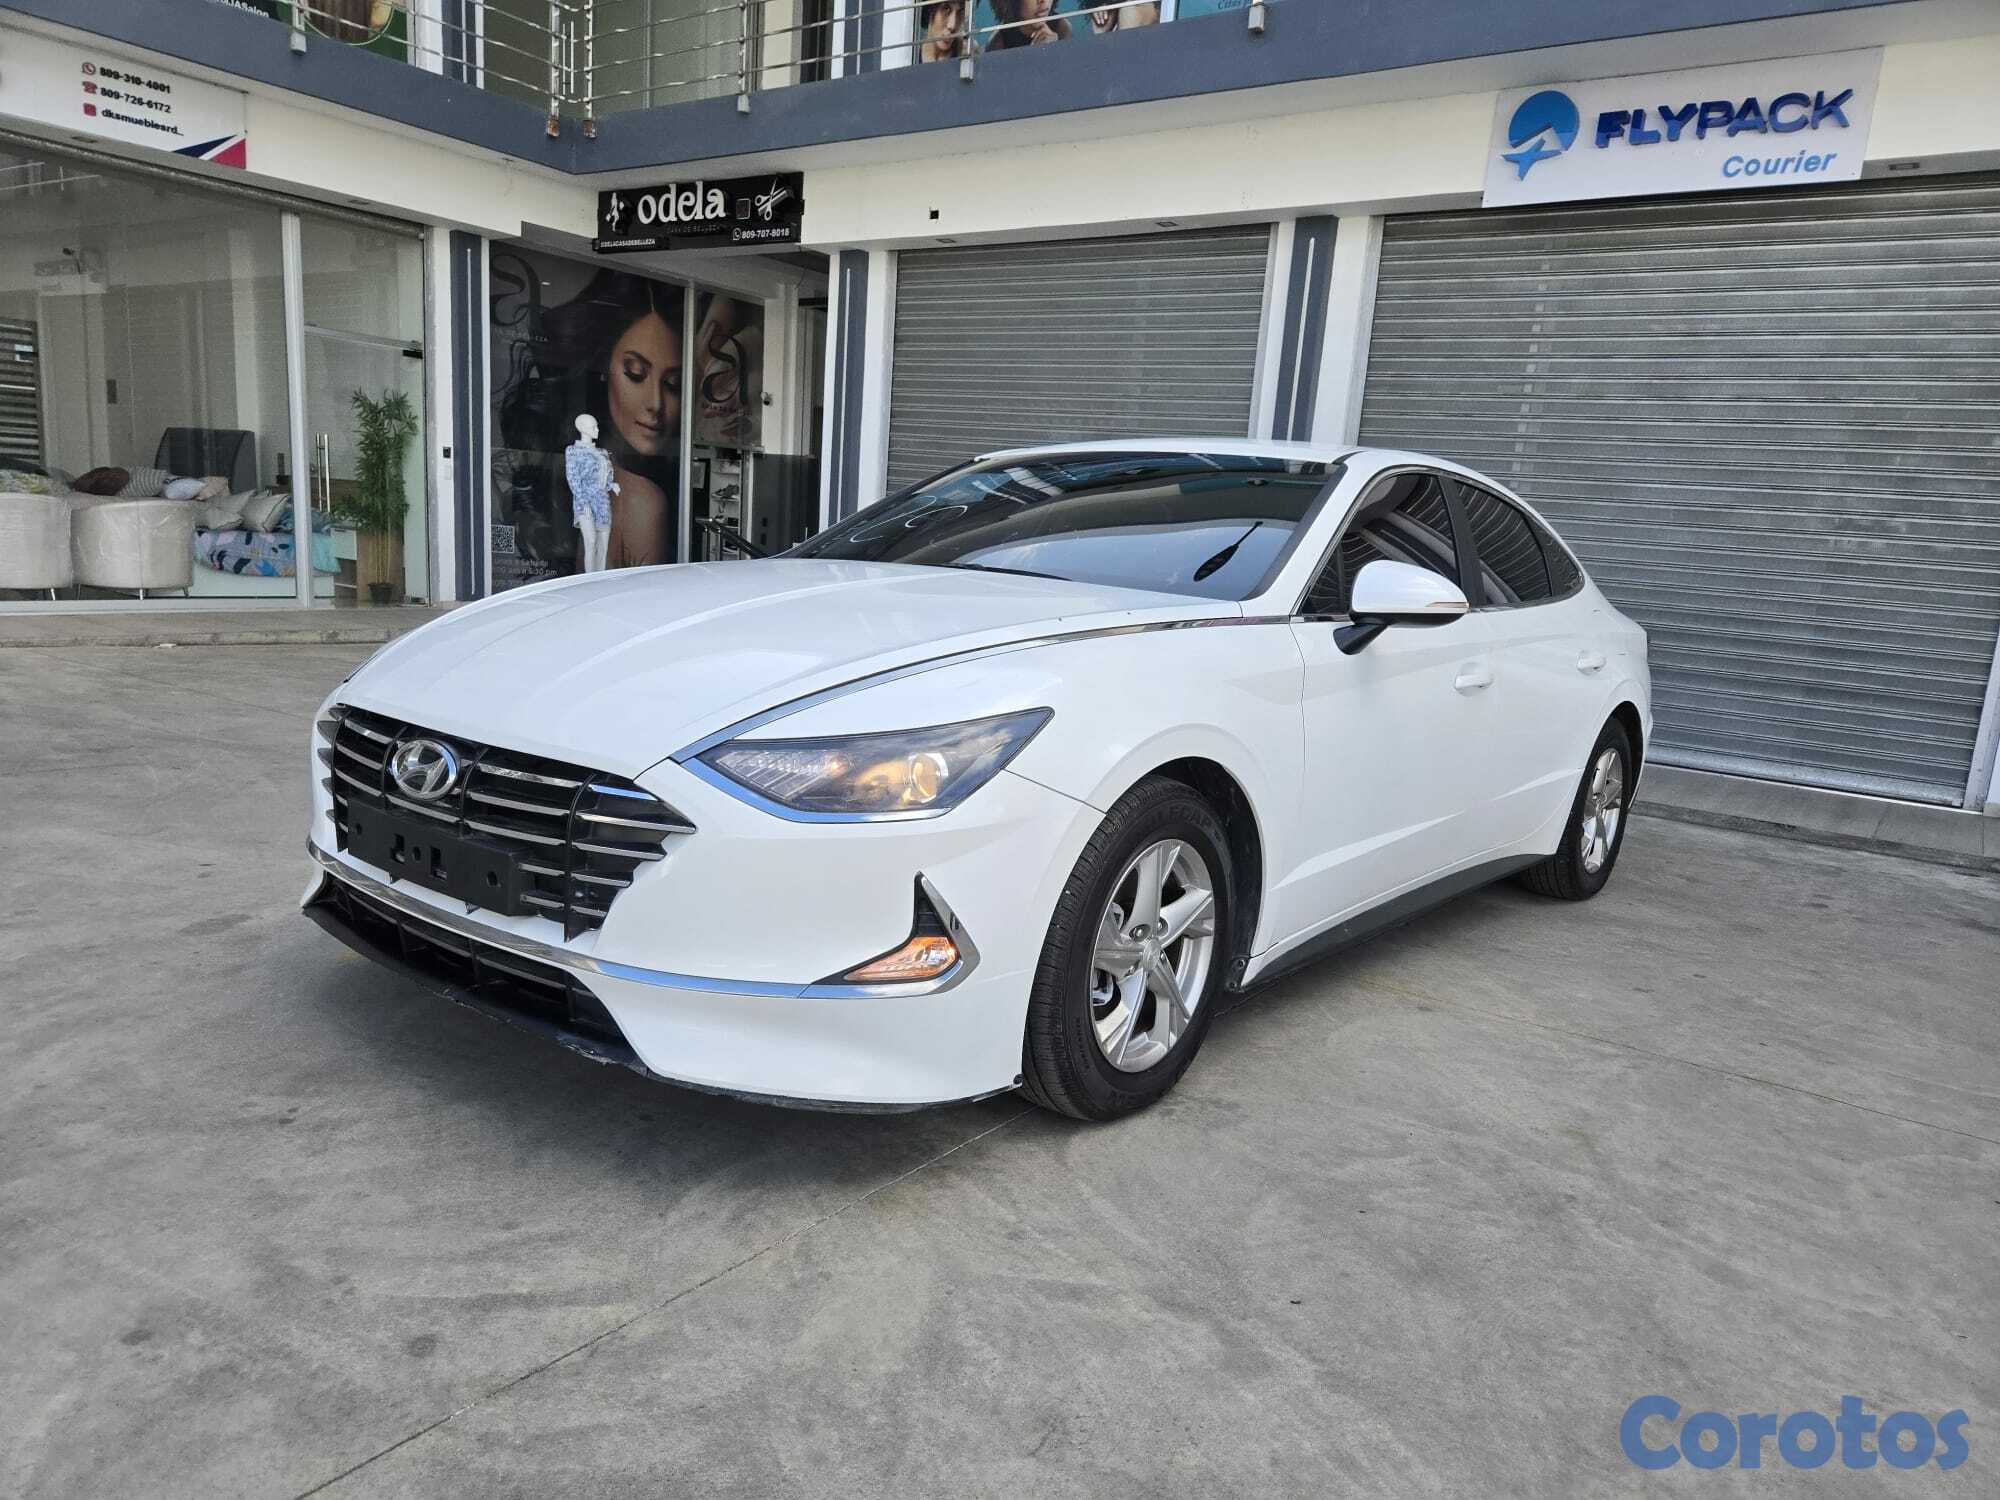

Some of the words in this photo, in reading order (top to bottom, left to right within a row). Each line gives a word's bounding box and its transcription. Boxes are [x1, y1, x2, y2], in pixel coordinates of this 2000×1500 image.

[101, 88, 172, 114] 809-726-6172
[1595, 89, 1853, 148] FLYPACK
[1722, 150, 1837, 178] Courier
[637, 181, 726, 225] odela
